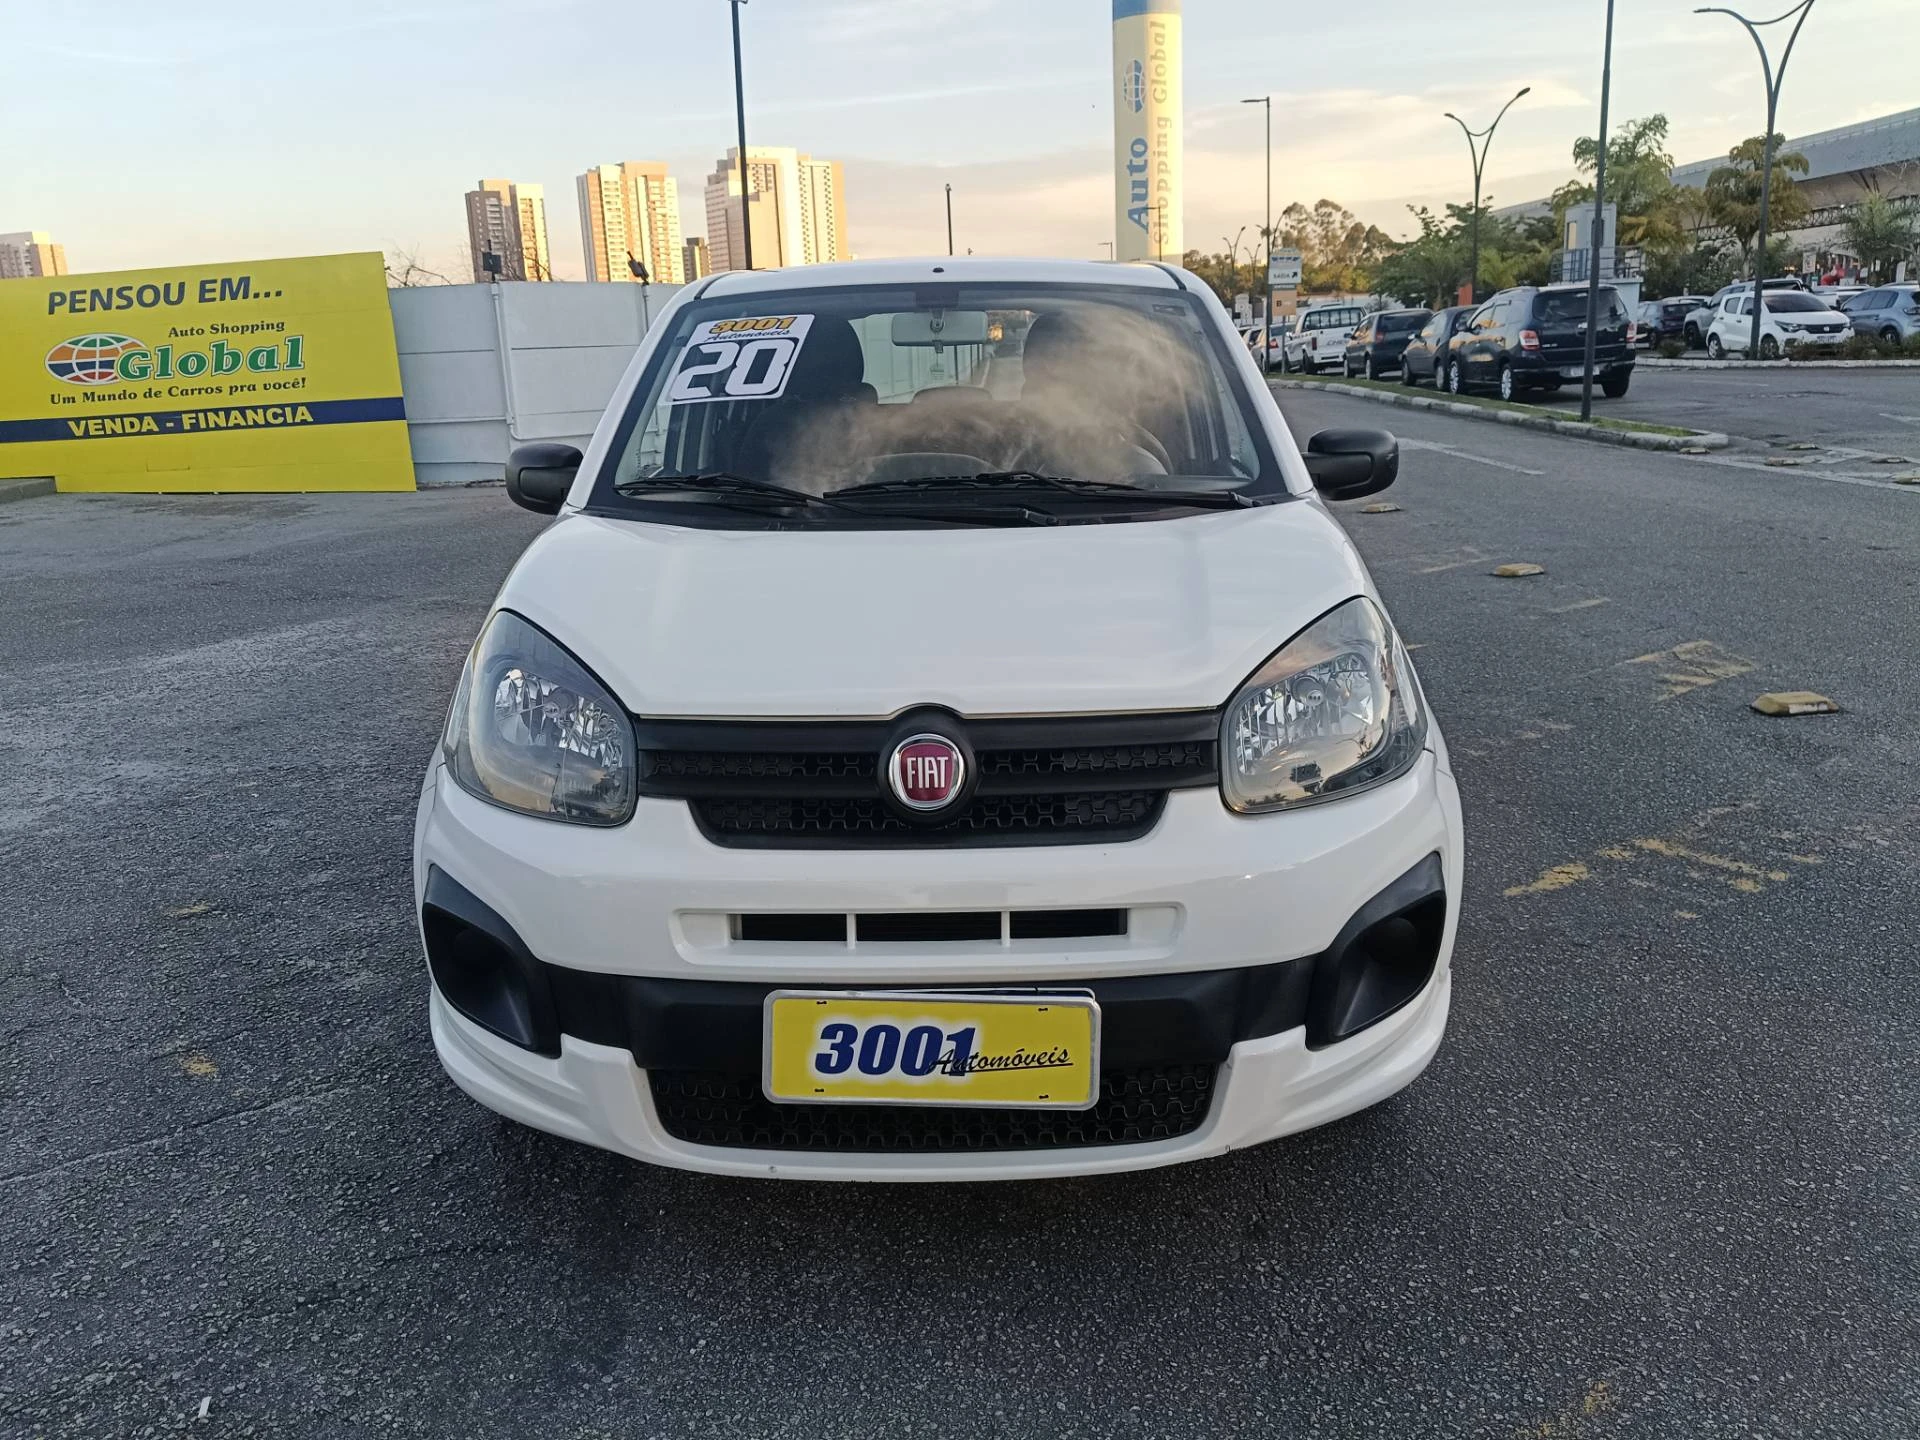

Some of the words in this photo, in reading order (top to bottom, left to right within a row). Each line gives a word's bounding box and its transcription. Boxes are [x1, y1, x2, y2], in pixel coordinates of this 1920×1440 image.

[1150, 20, 1168, 105] Global
[1128, 137, 1149, 234] Auto
[1153, 116, 1172, 246] Shopping
[48, 281, 186, 315] PENSOU
[198, 276, 283, 304] EM...
[168, 324, 205, 338] Auto
[209, 320, 286, 337] Shopping
[708, 317, 798, 335] 3001
[116, 334, 306, 382] Global
[669, 338, 797, 401] 20
[50, 393, 77, 405] Um
[82, 388, 137, 404] Mundo
[143, 386, 163, 399] de
[168, 383, 223, 397] Carros
[228, 382, 257, 396] pra
[262, 377, 307, 391] você!
[68, 416, 160, 438] VENDA
[182, 405, 314, 431] FINANCIA
[906, 756, 949, 789] FIAT
[815, 1023, 976, 1077] 3001
[926, 1046, 1073, 1075] Automóveis
